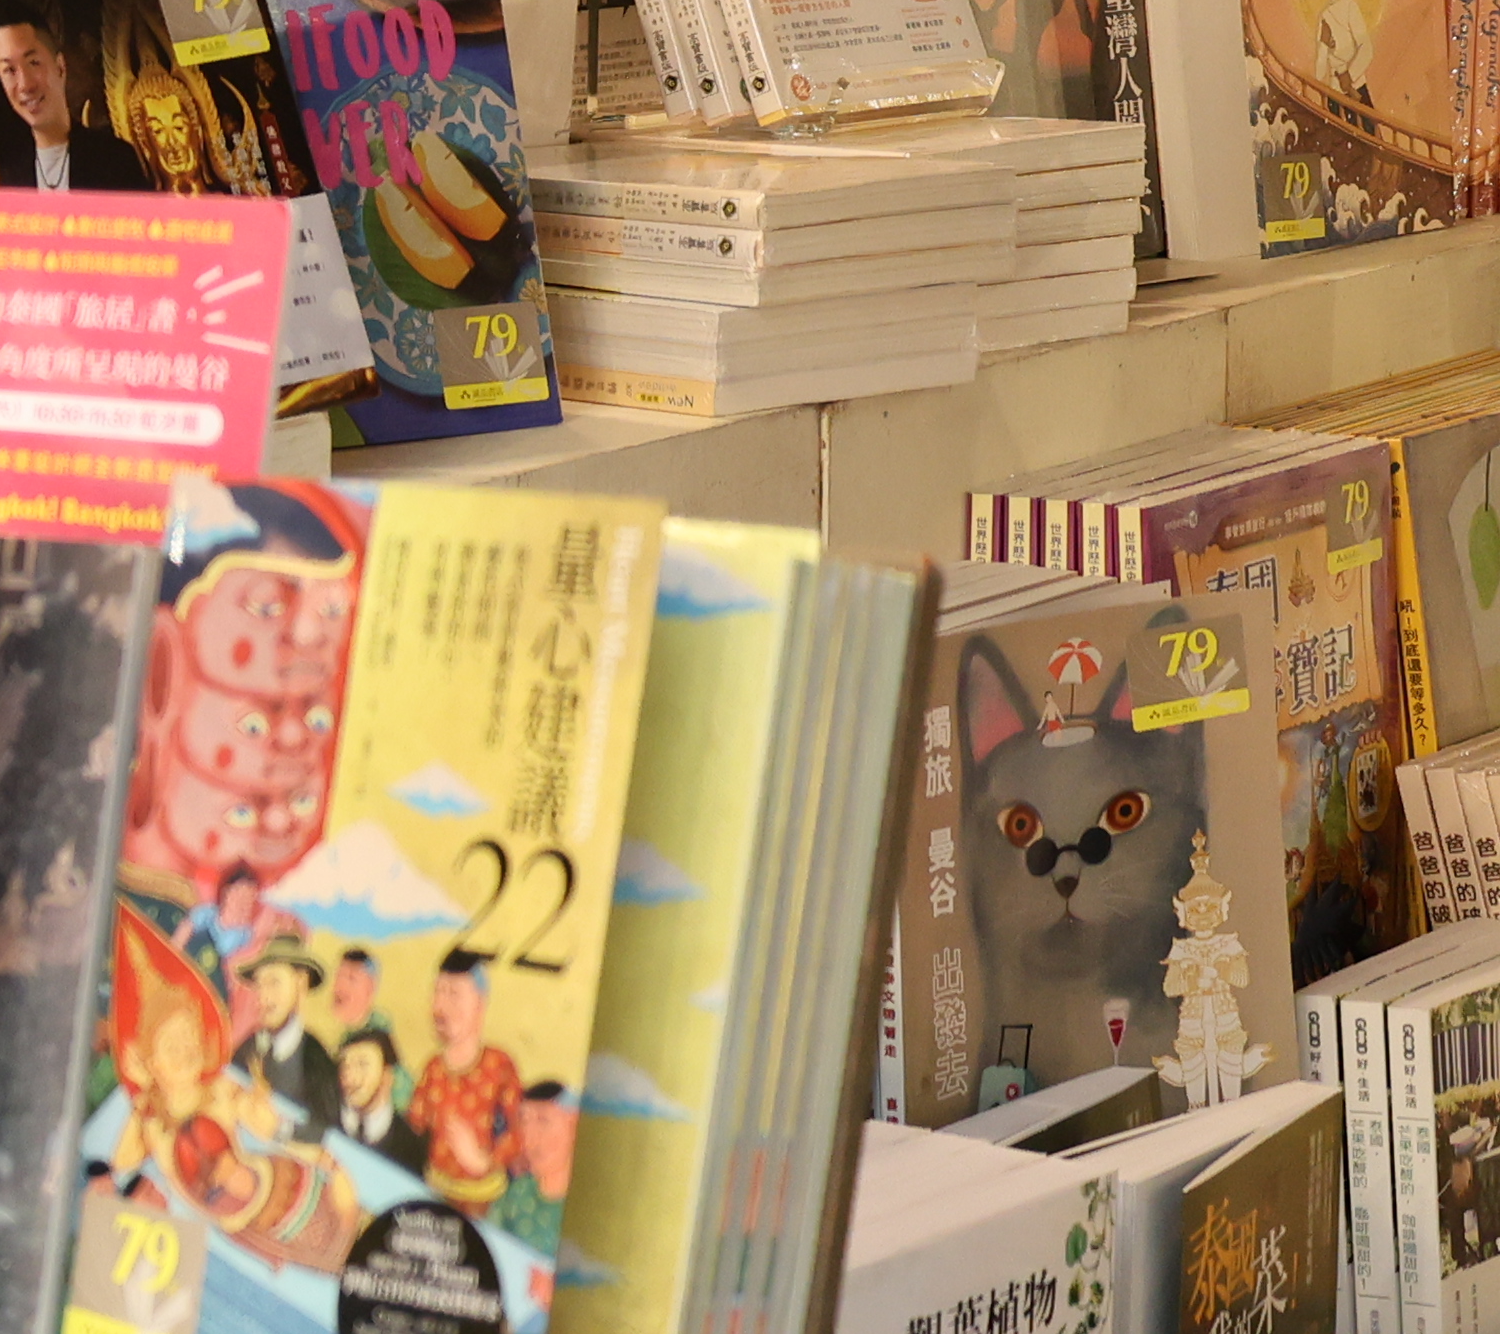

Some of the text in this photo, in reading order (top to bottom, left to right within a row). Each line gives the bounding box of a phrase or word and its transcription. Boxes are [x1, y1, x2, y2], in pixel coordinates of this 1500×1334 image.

[1280, 160, 1312, 201] 79
[464, 312, 521, 361] 79
[1341, 478, 1370, 523] 79
[1159, 627, 1218, 679] 79
[1398, 599, 1429, 747] 吼！到底還要等多久？
[439, 838, 578, 975] 22
[924, 703, 971, 1103] 獨旅 曼谷 出發去
[1412, 831, 1452, 924] 爸爸的破
[111, 1211, 182, 1297] 79
